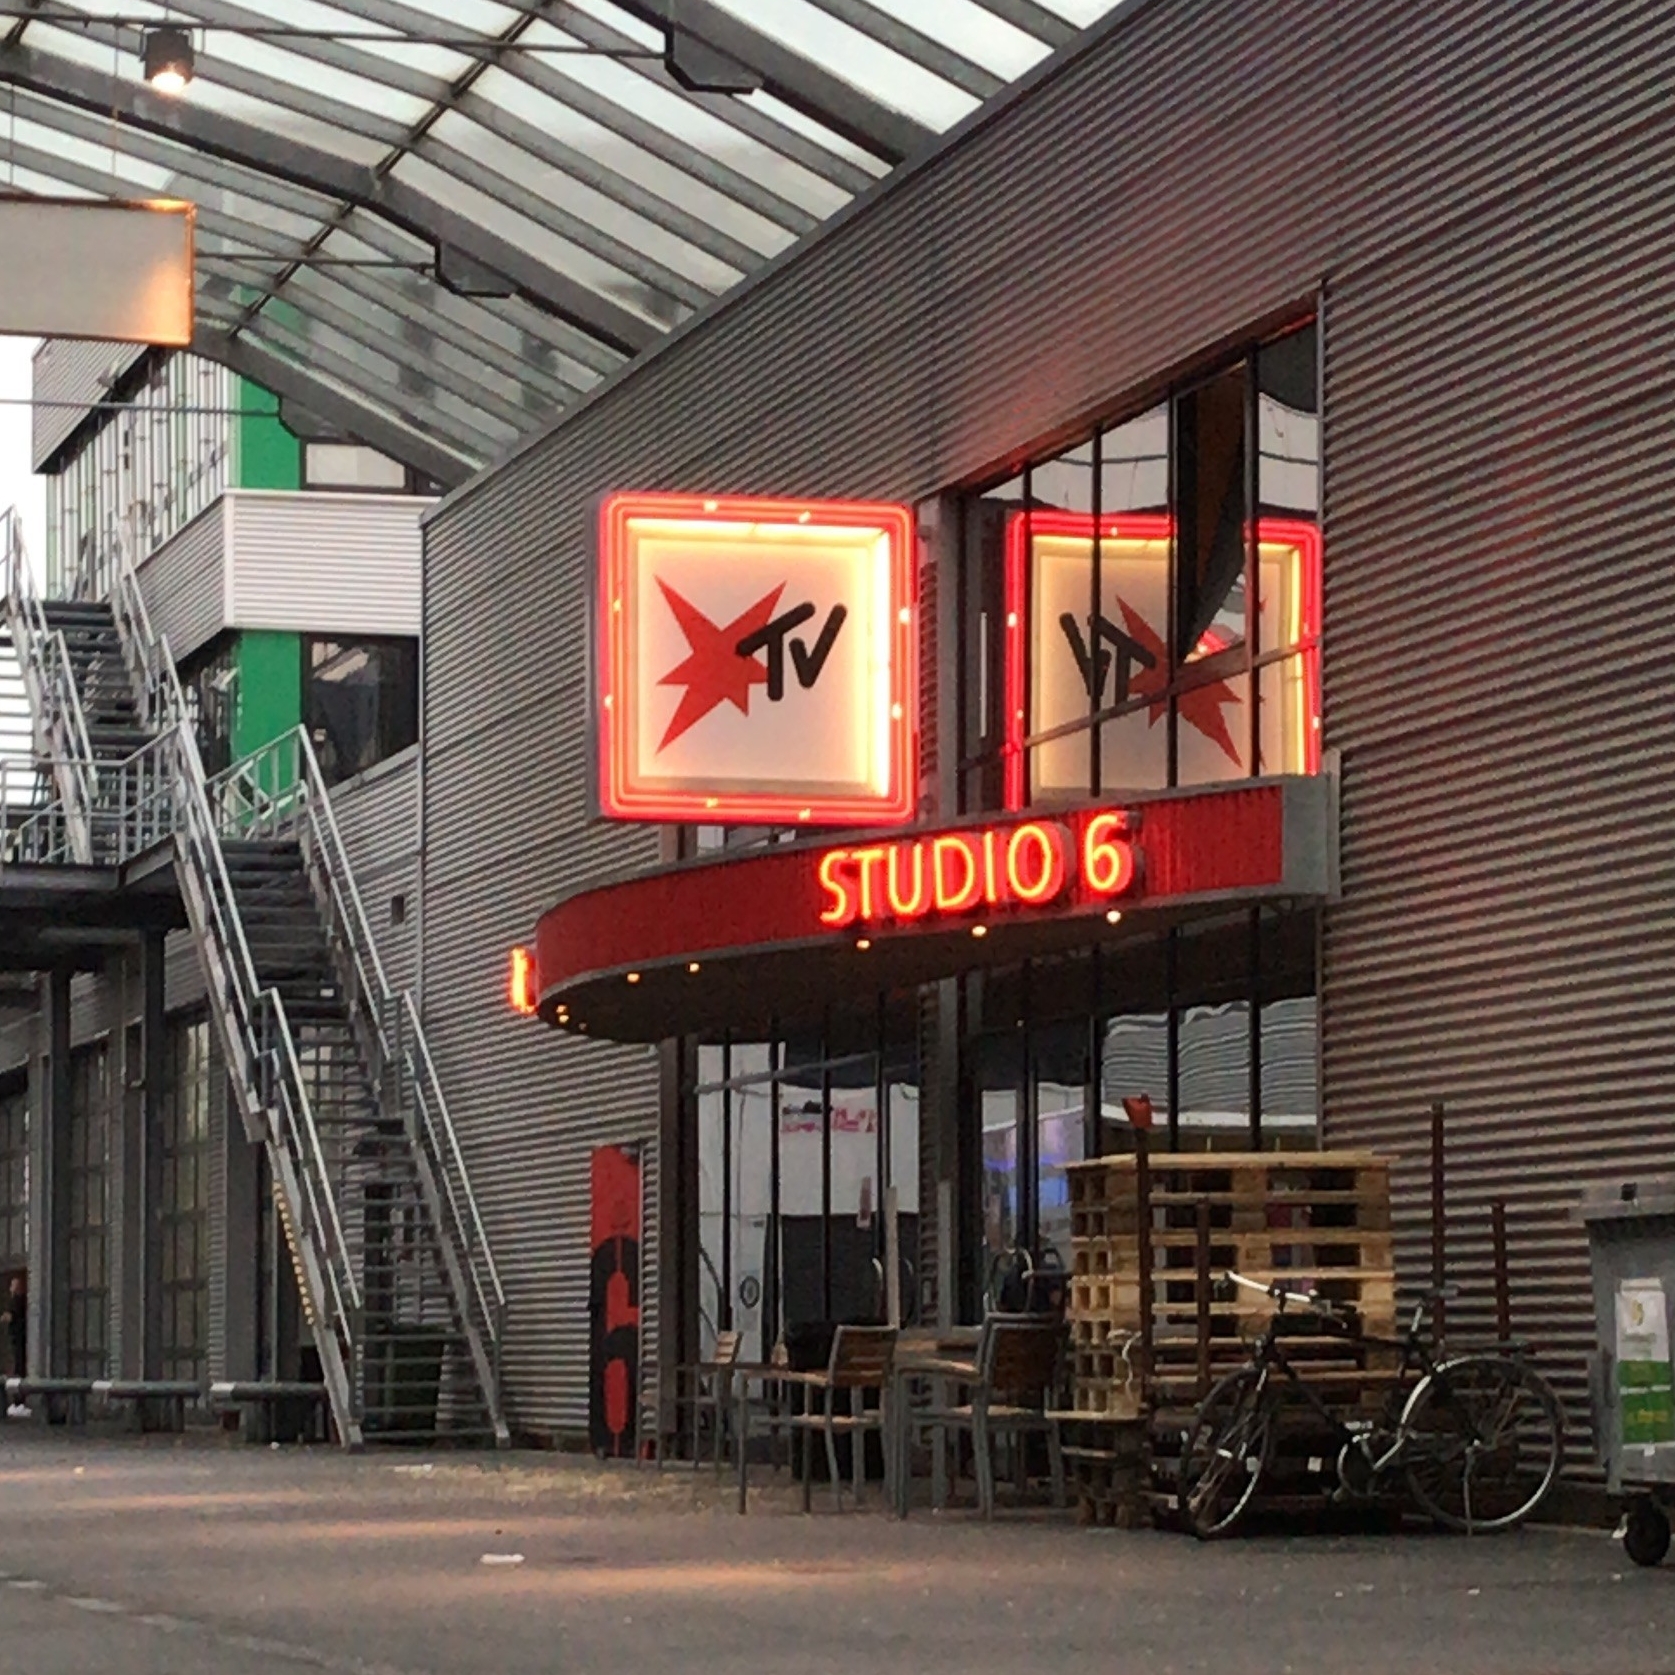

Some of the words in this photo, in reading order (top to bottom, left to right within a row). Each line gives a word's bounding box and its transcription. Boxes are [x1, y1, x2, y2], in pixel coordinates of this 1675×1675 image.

[735, 601, 847, 702] TV
[819, 822, 1064, 924] STUDIO
[1084, 813, 1133, 895] 6
